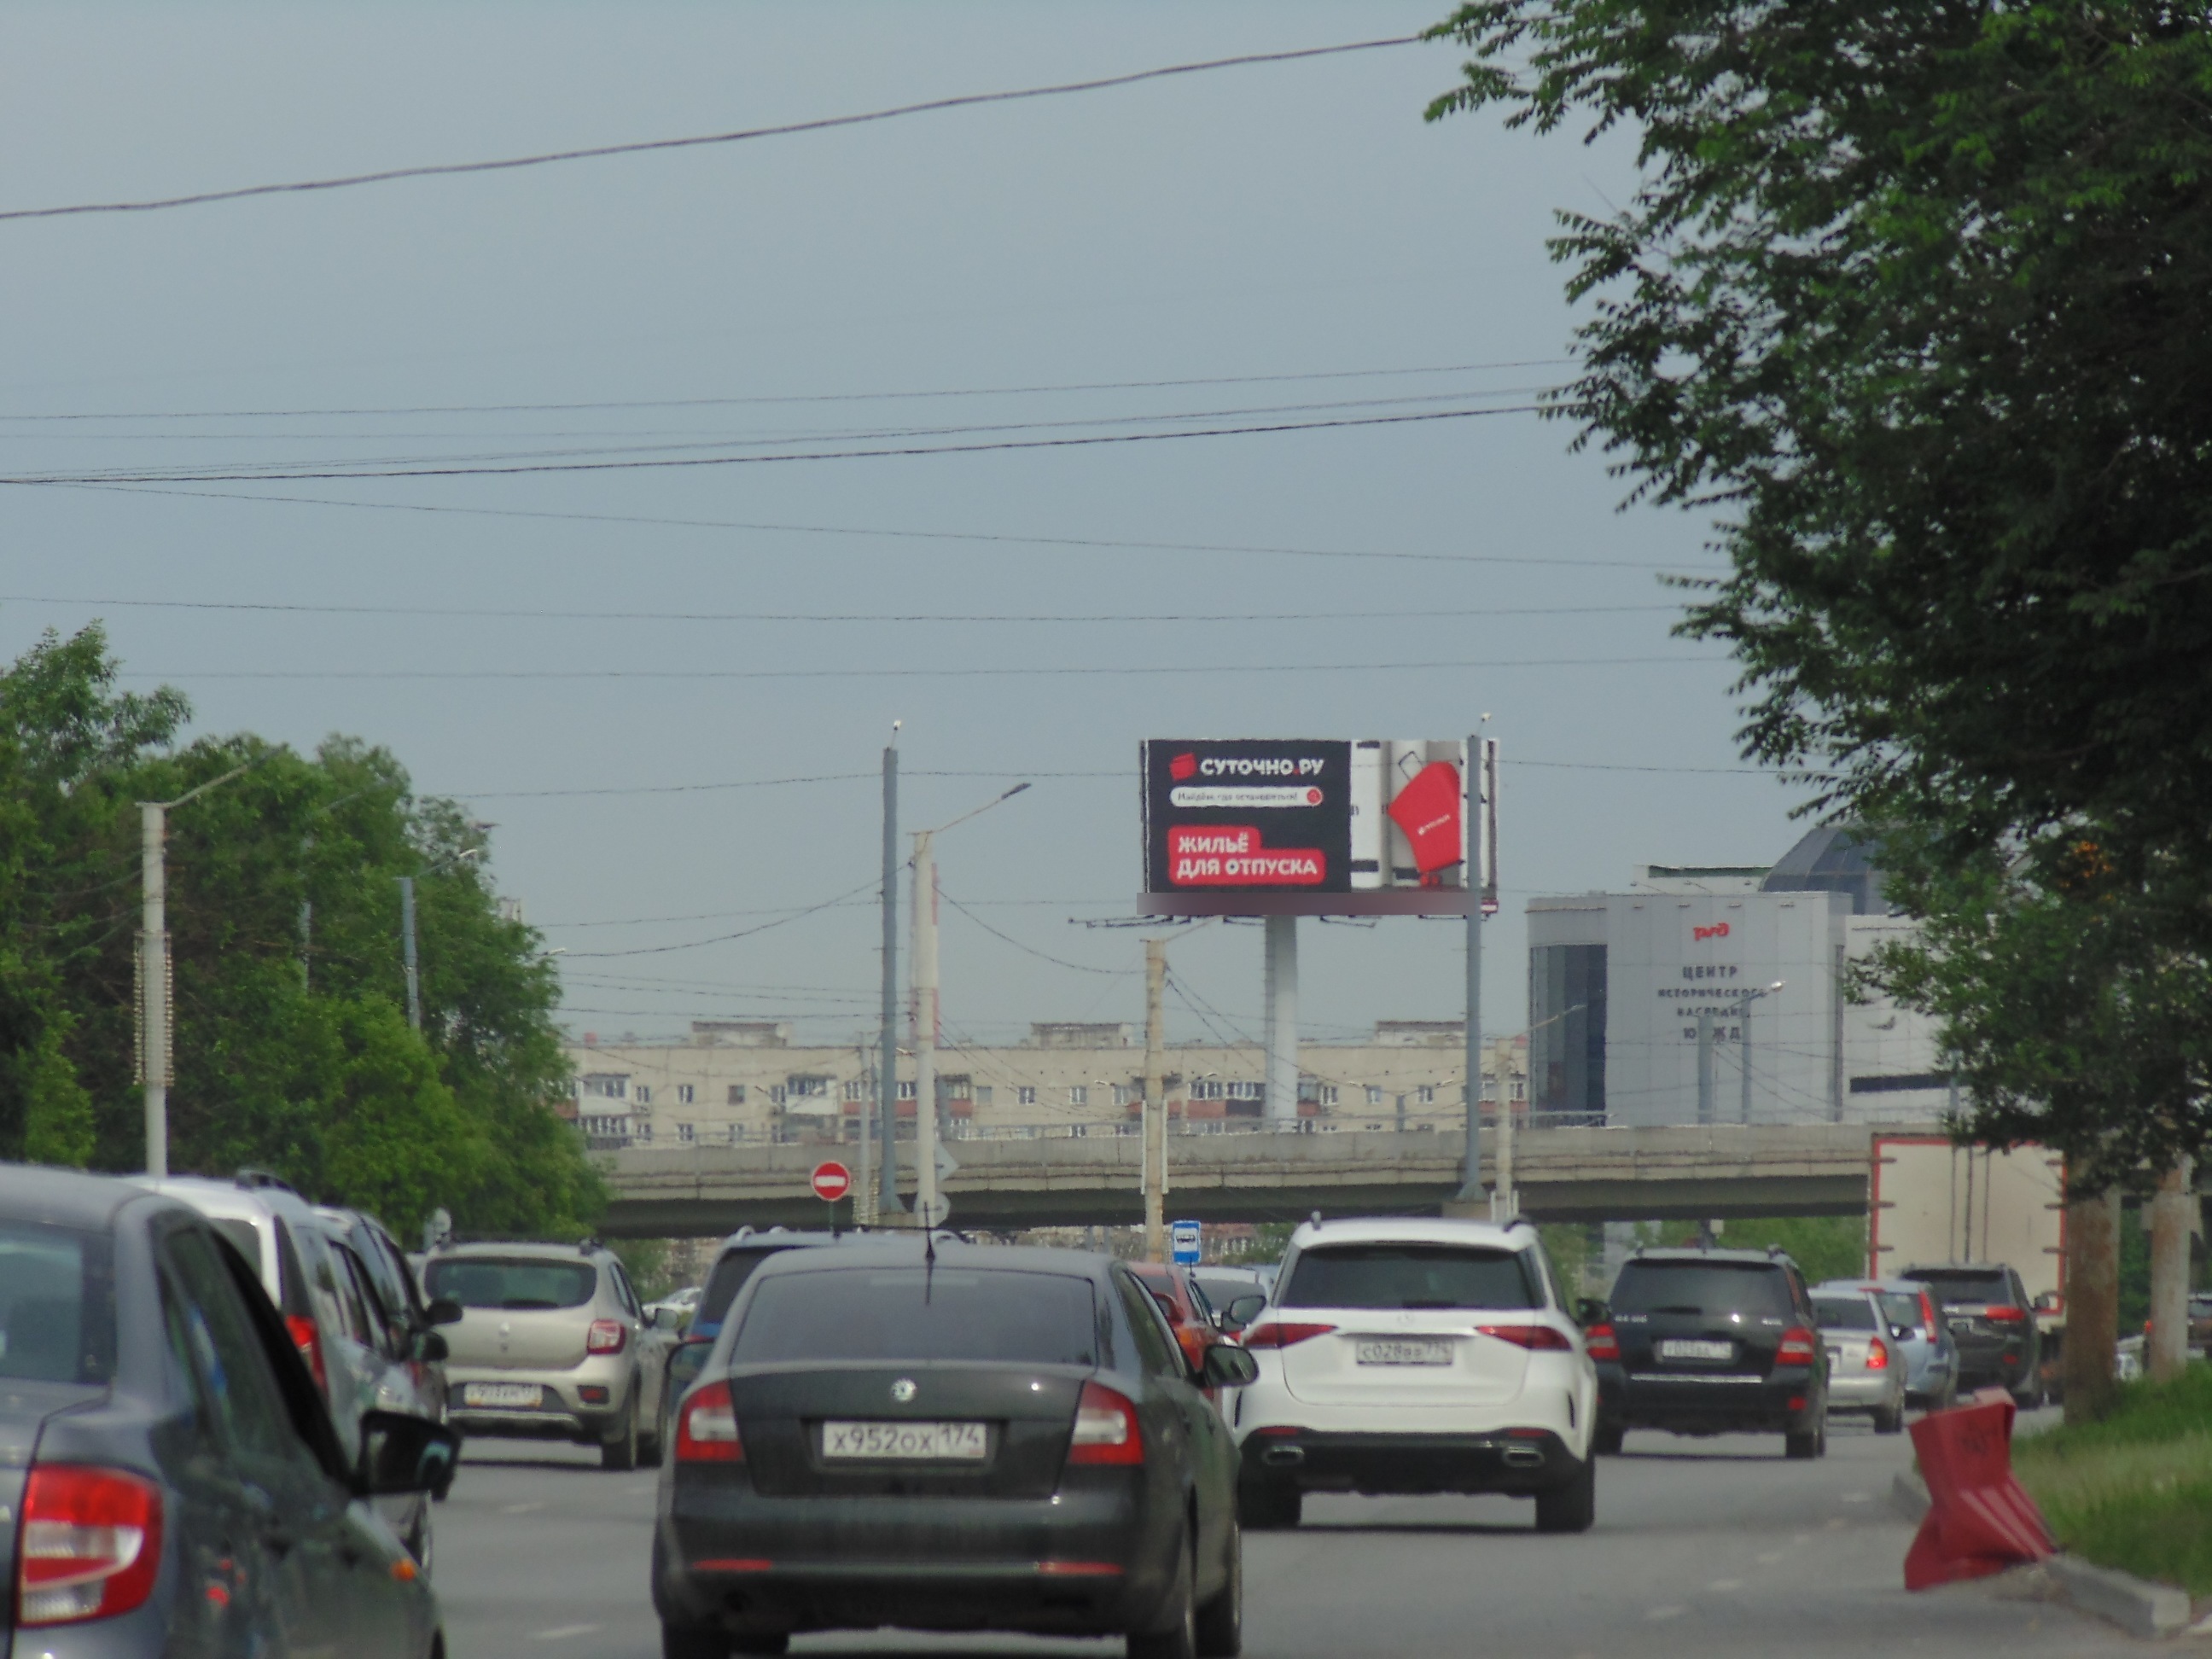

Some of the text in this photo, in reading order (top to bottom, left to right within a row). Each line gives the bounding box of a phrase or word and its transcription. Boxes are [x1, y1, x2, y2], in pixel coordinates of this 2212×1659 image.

[1200, 759, 1324, 776] СУТОЧНО.РУ
[1179, 831, 1249, 853] ЖИЛЬЁ
[1177, 859, 1318, 879] ДЛЯ ОТПУСКА
[1682, 966, 1738, 981] ЦЕНТР
[1677, 1007, 1744, 1017] НАСЛЕДИ
[1684, 1027, 1741, 1041] ЮЖД
